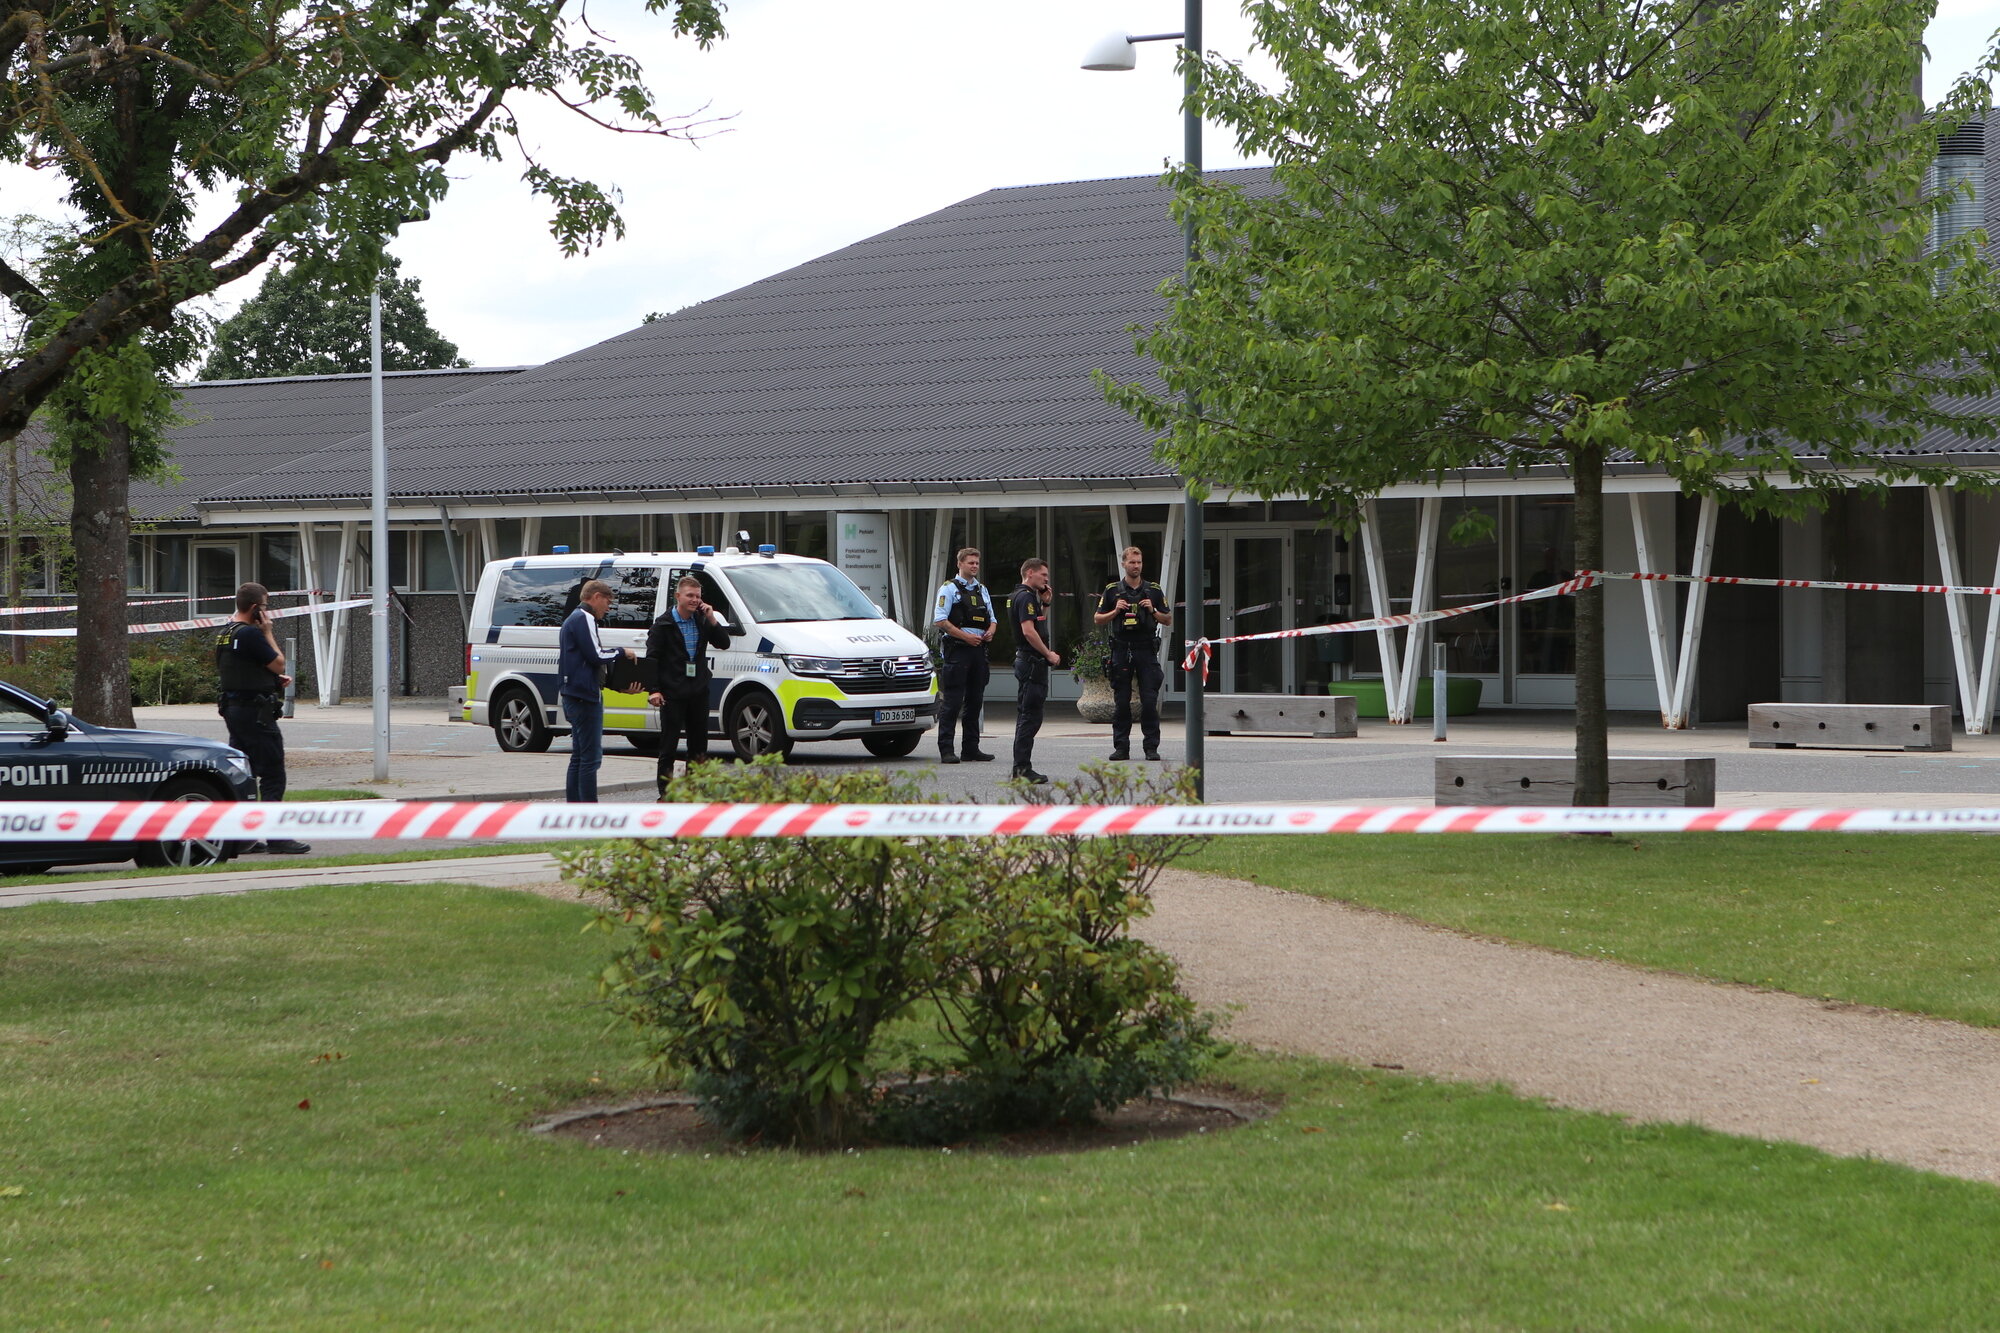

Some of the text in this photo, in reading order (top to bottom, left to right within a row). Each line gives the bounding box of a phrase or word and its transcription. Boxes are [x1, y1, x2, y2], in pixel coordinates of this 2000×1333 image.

[846, 635, 896, 643] POLITI
[880, 711, 891, 721] DD
[891, 711, 900, 720] 36
[0, 764, 69, 786] POLITI
[278, 809, 365, 826] POLITI
[540, 814, 629, 830] POLITI
[886, 810, 981, 824] POLITI
[1176, 812, 1275, 827] POLITI
